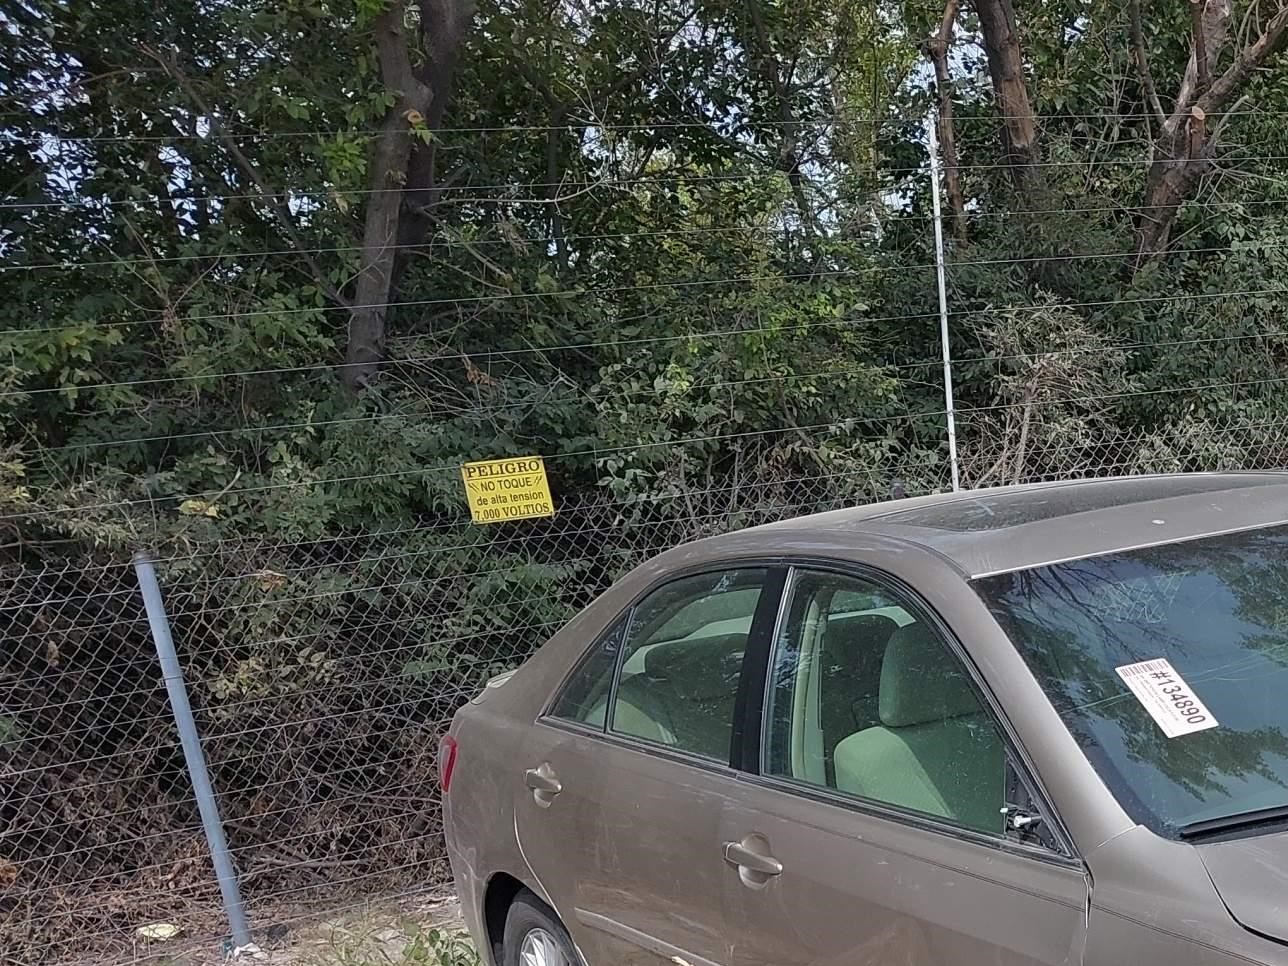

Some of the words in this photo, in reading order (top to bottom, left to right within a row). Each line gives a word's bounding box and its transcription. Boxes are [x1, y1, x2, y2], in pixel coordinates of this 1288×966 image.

[466, 460, 540, 478] PELIGRO
[480, 481, 496, 492] NO
[497, 477, 533, 490] TOQUE
[477, 496, 488, 506] de
[491, 494, 507, 505] alta
[510, 491, 544, 502] tension
[475, 508, 500, 520] 7,000
[502, 502, 550, 517] VOLTIOS
[1149, 671, 1207, 725] #134890
